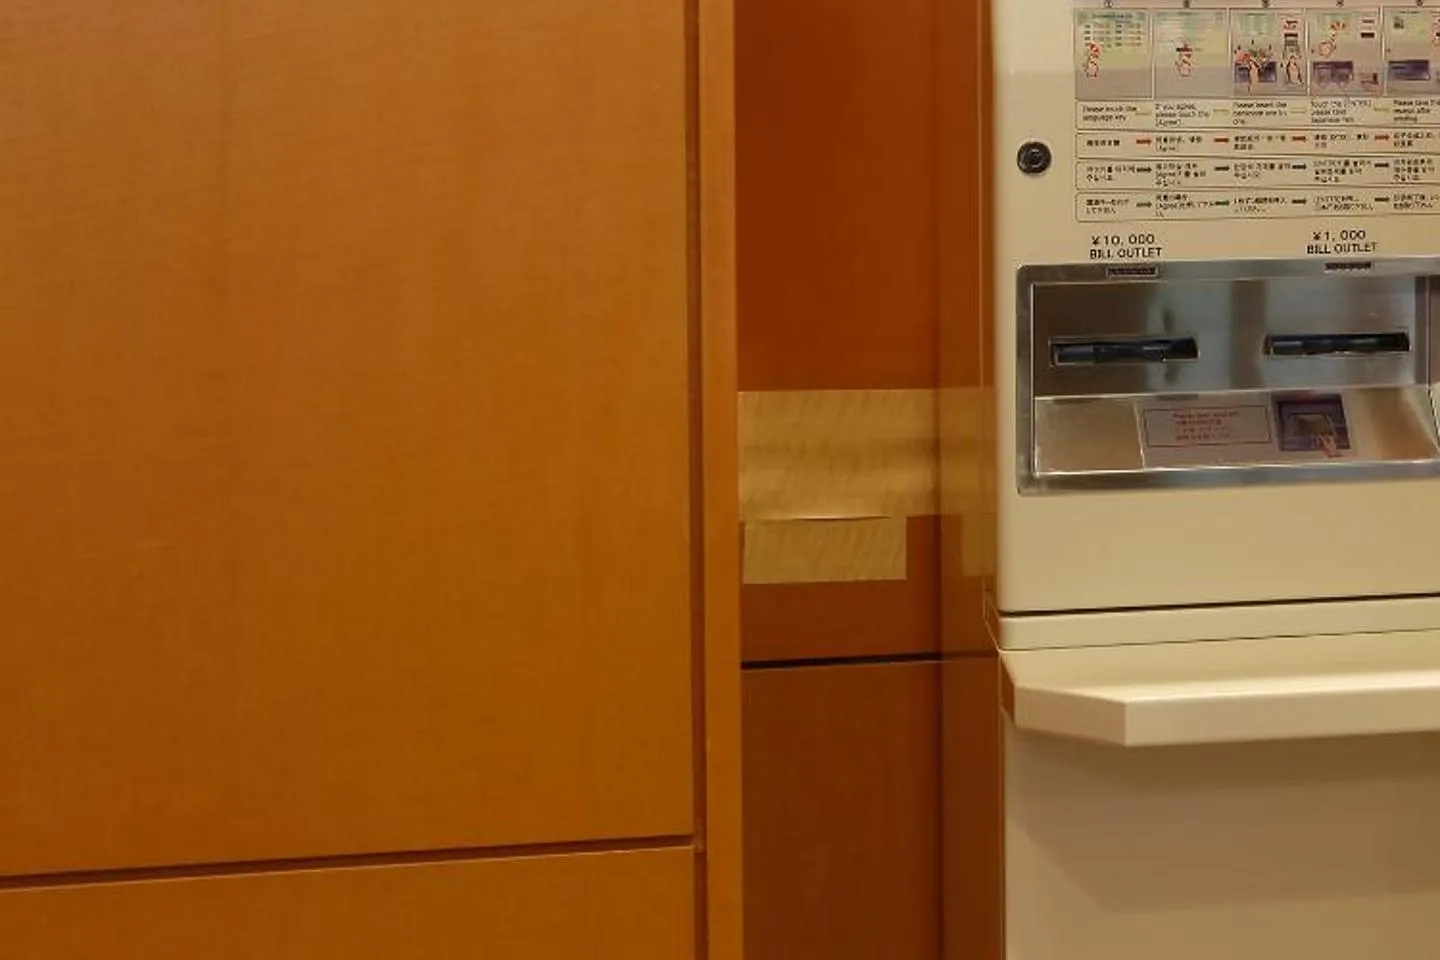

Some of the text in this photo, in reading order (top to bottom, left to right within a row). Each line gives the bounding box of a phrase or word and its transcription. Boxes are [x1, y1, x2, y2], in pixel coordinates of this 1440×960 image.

[1090, 246, 1163, 260] BILL OUTLET
[1307, 242, 1378, 255] BILL OUTLET
